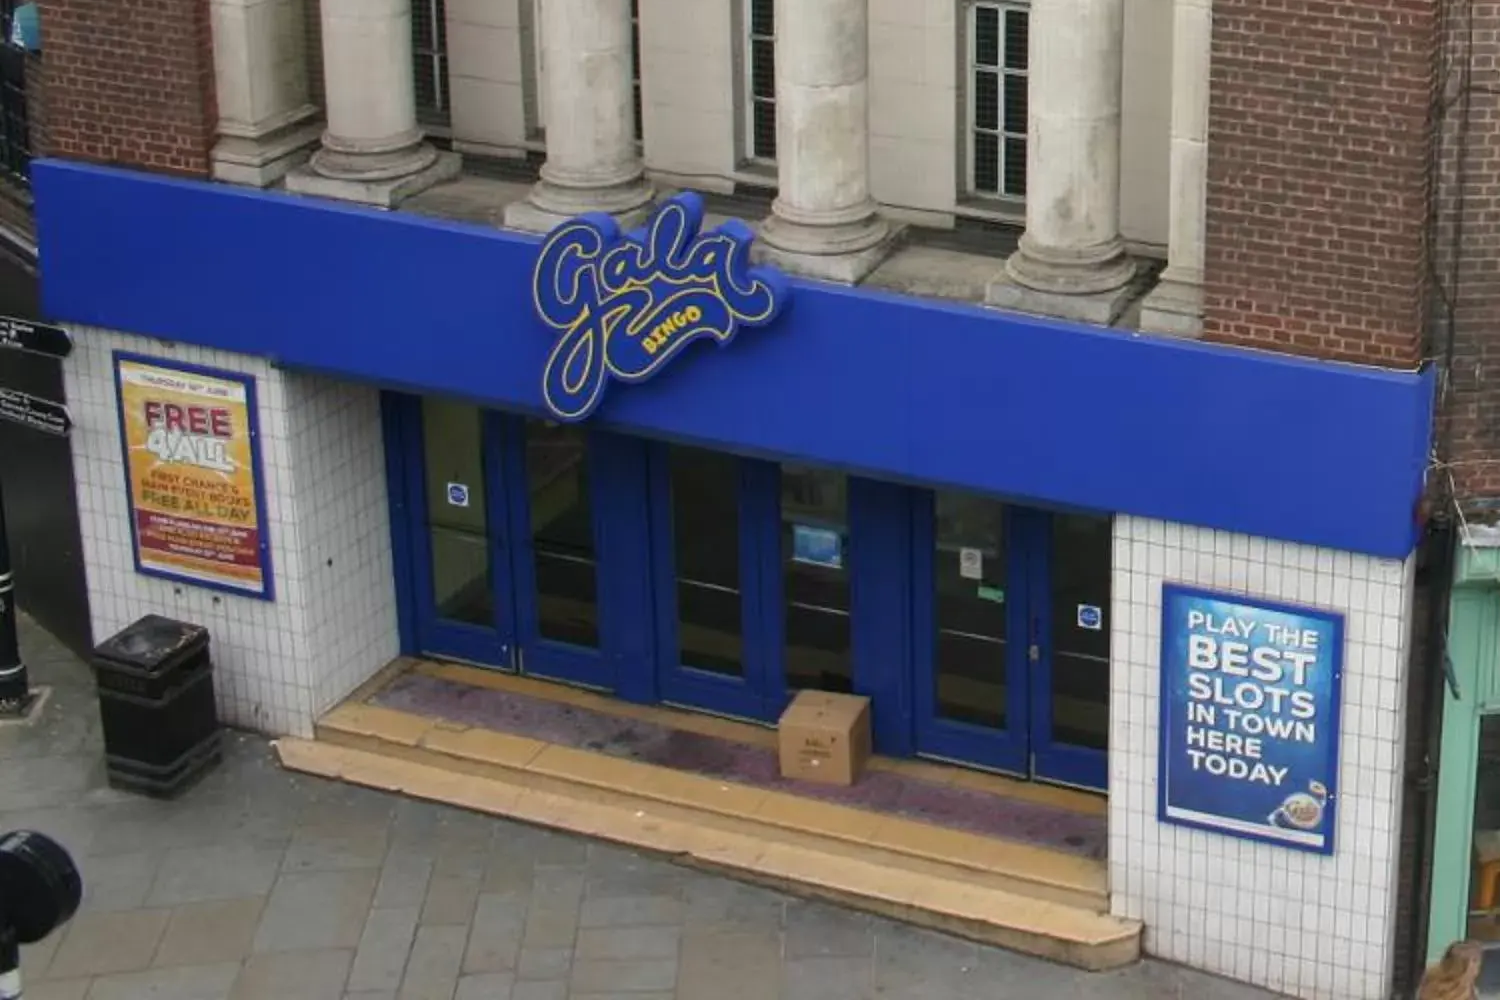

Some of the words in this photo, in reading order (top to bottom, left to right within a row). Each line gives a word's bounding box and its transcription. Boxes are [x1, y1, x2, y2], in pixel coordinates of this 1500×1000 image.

[533, 203, 773, 417] Gala
[641, 305, 701, 354] BINGO
[145, 401, 232, 437] FREE
[142, 490, 180, 509] FREE
[183, 499, 217, 515] ALL
[217, 505, 250, 520] DAY
[1188, 610, 1255, 639] PLAY
[1264, 623, 1319, 649] THE
[1188, 634, 1316, 685] BEST
[1188, 673, 1315, 718] SLOTS
[1187, 701, 1214, 725] IN
[1223, 709, 1315, 743] TOWN
[1187, 726, 1262, 758] HERE
[1186, 750, 1288, 786] TODAY
